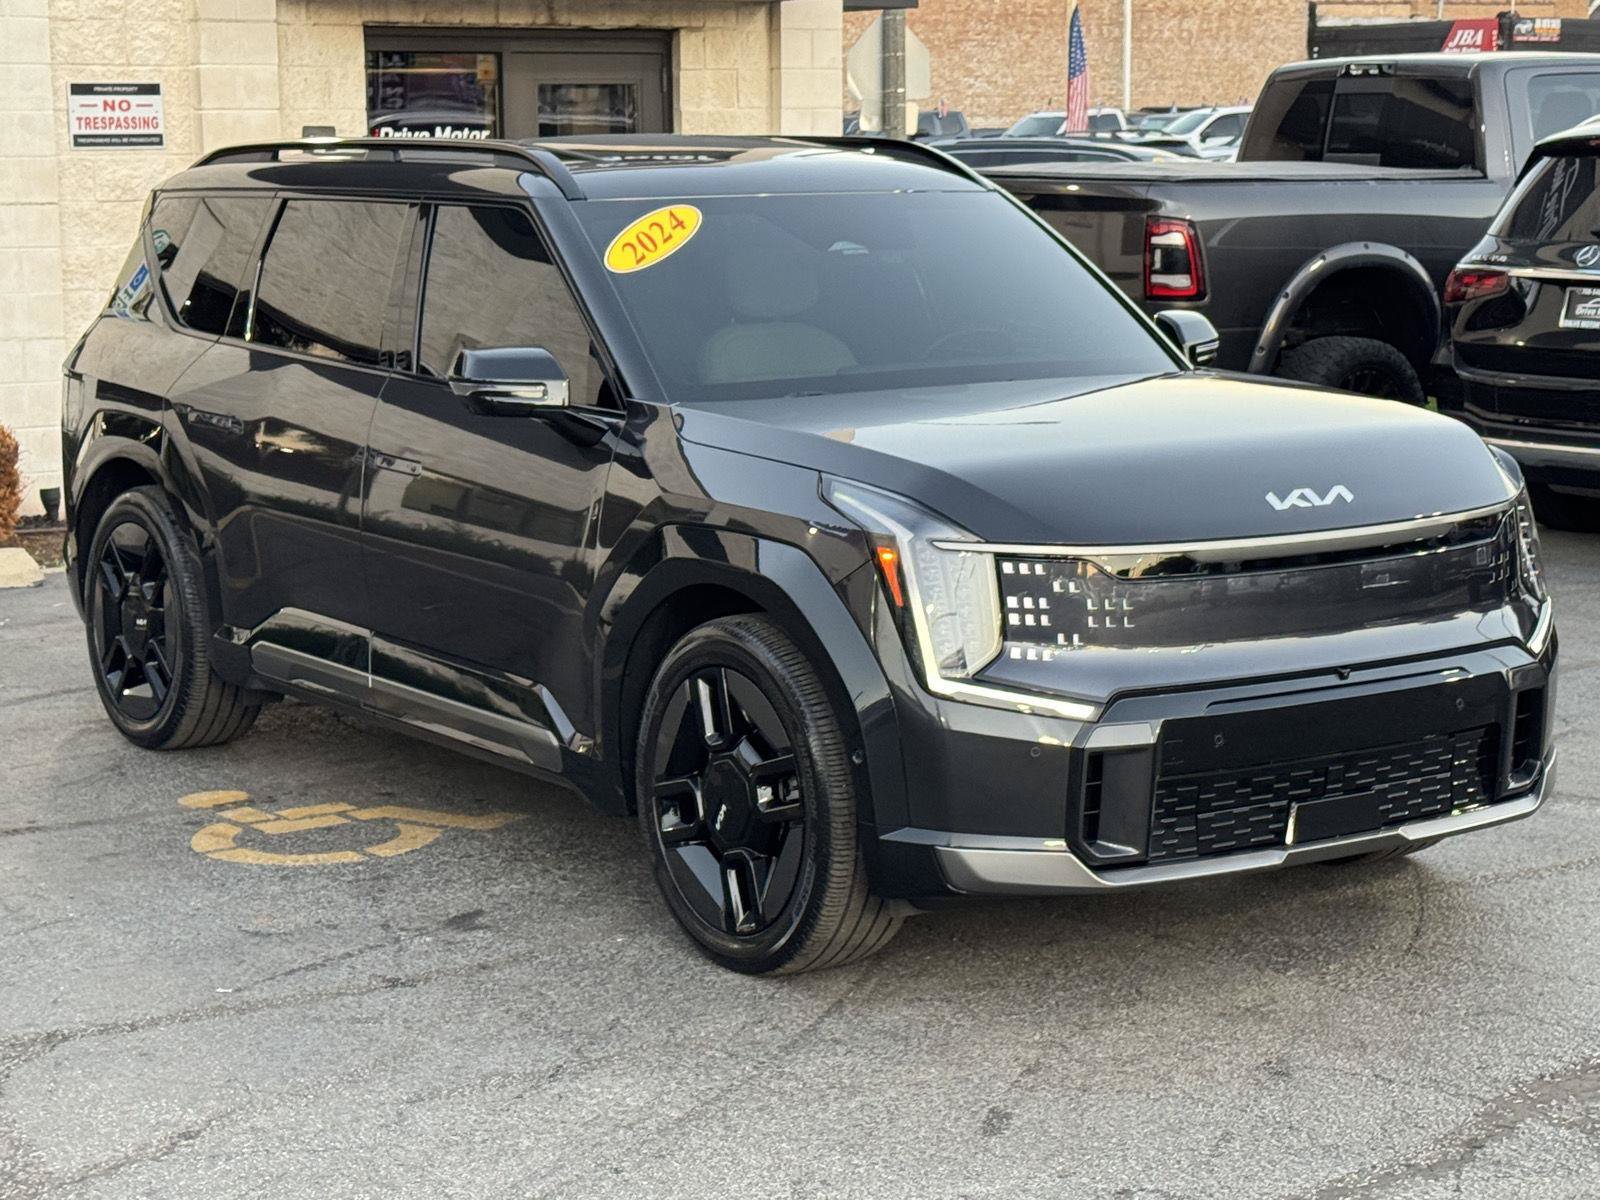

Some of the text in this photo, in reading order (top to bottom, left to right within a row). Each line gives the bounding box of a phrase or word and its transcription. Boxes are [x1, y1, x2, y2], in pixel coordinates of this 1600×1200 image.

[1448, 29, 1484, 48] JBA
[102, 99, 132, 112] NO
[76, 116, 160, 130] TRESPASSING
[621, 209, 687, 266] 2024
[1265, 485, 1355, 511] KIA
